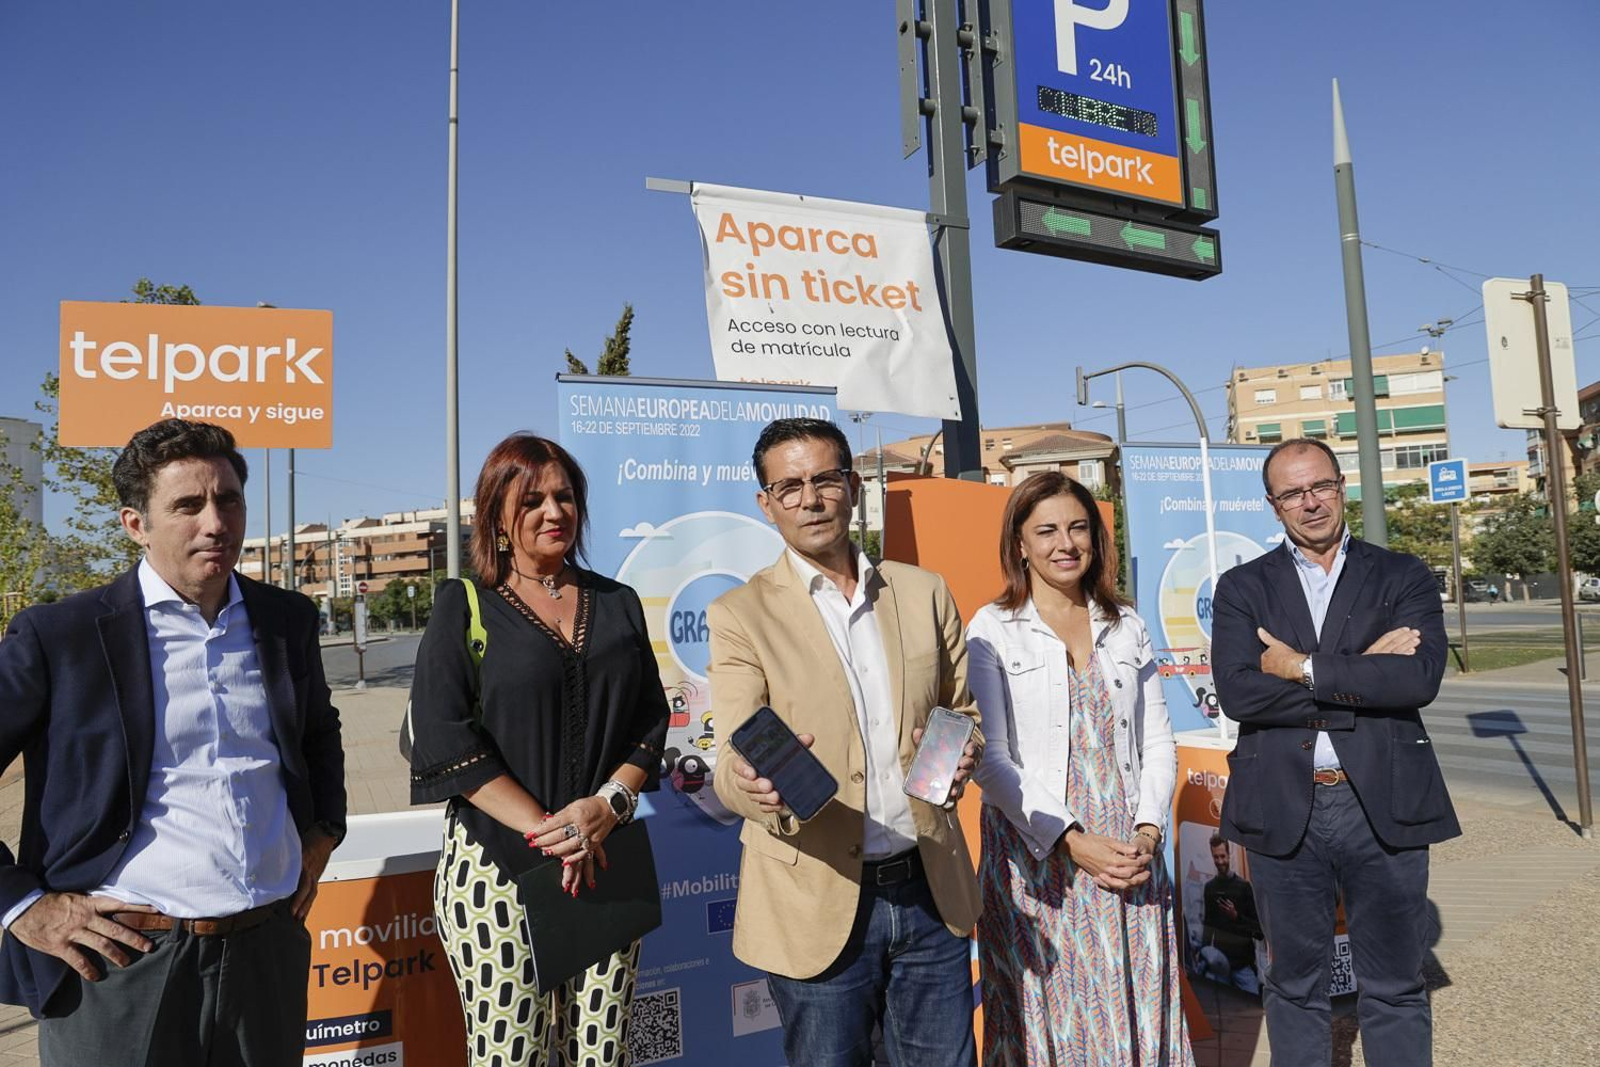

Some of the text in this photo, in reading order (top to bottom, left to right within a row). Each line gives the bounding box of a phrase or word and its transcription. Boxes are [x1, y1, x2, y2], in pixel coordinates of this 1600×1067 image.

[1054, 0, 1130, 75] P
[1089, 58, 1132, 89] 24h
[1047, 136, 1155, 185] telpark
[715, 212, 879, 259] Aparca
[720, 262, 923, 312] sin ticket
[727, 318, 900, 342] Acceso con lectura
[69, 331, 325, 393] telpark
[731, 339, 852, 358] de matrícula
[160, 402, 325, 425] Aparca y sigue
[571, 420, 701, 437] 16-22 DE SEPTIEMBRE 2022
[617, 458, 759, 486] ¡Combina y muév
[1219, 496, 1264, 512] muévete!
[1196, 597, 1213, 619] GR
[670, 610, 709, 644] GRA
[1187, 768, 1229, 792] telpa
[660, 873, 738, 899] #Mobilit
[320, 911, 437, 949] movilid
[312, 949, 436, 990] Telpark
[306, 1020, 380, 1040] uímetro
